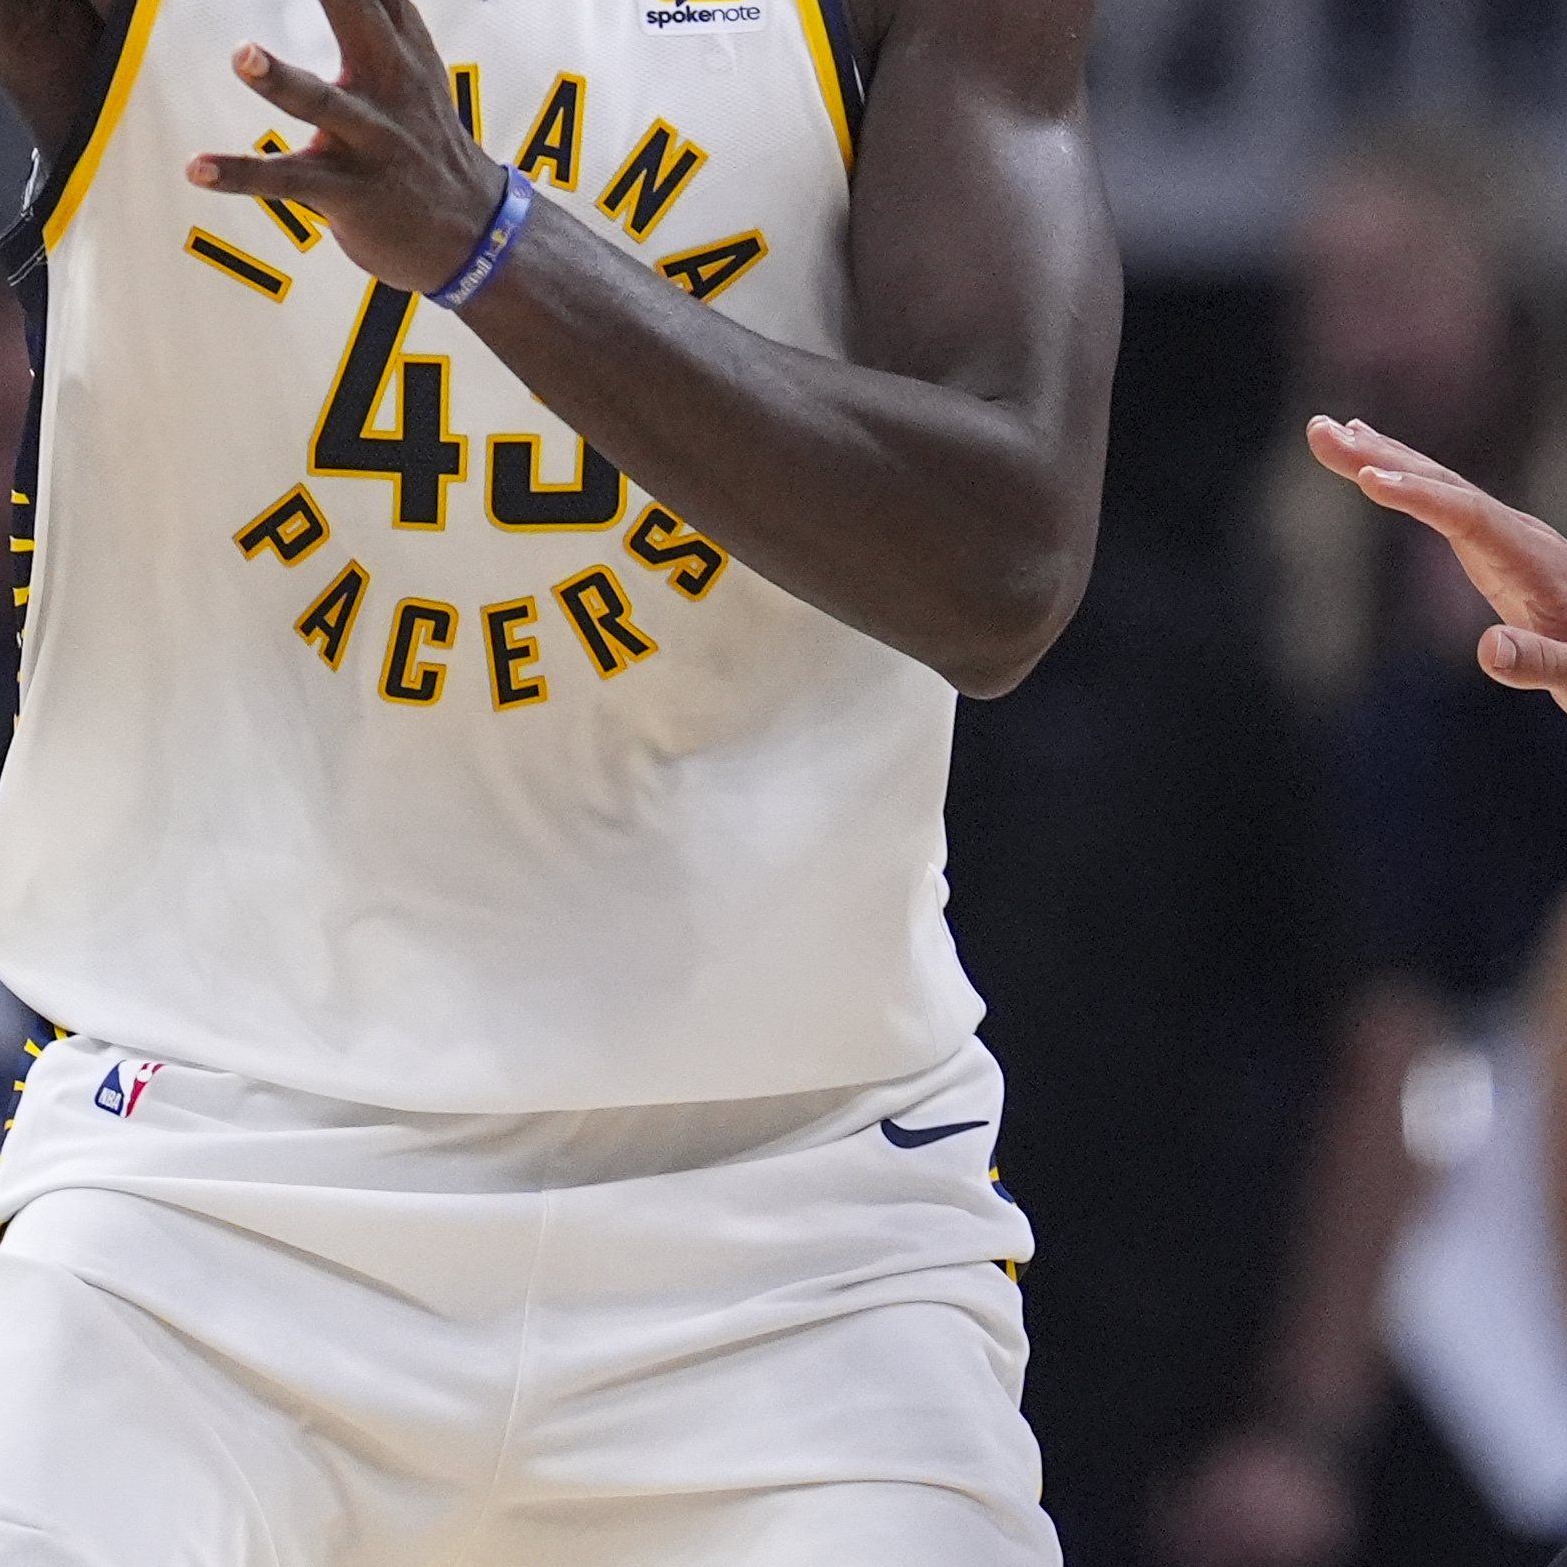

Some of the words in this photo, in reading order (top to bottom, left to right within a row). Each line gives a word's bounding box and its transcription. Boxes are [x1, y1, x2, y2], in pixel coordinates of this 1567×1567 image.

[645, 4, 761, 29] spokenote
[184, 62, 767, 304] IIANA
[232, 482, 729, 712] PACERS
[98, 1086, 123, 1112] NBA
